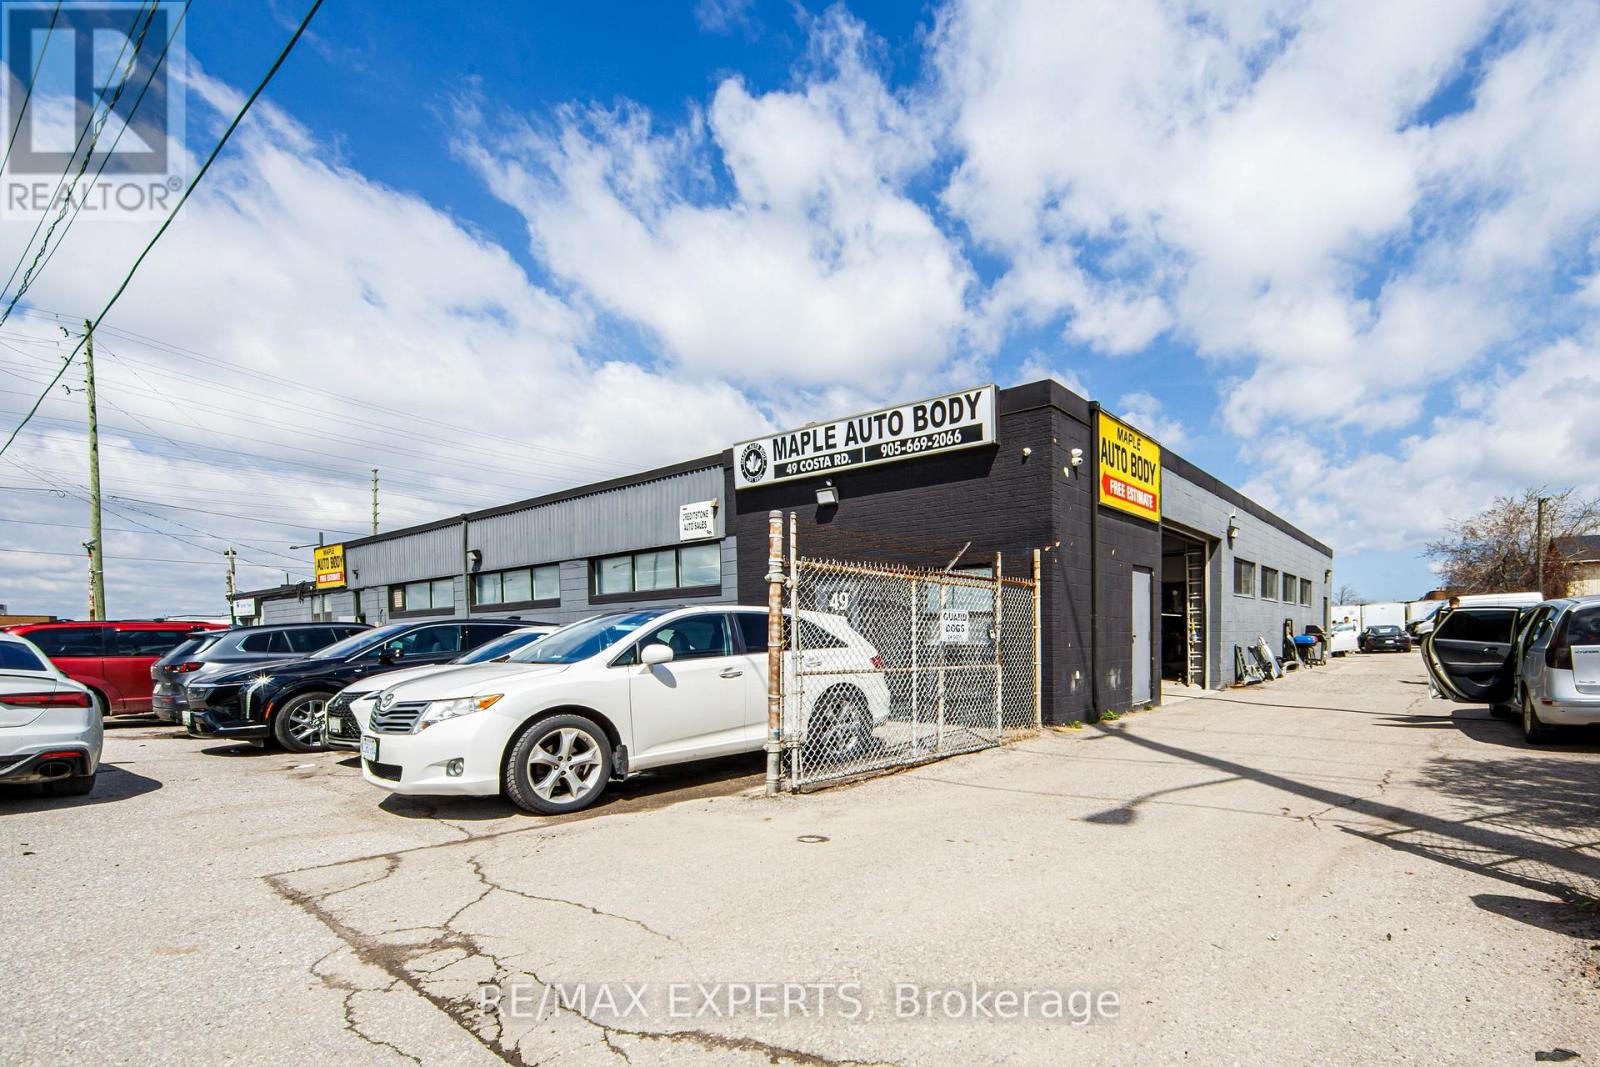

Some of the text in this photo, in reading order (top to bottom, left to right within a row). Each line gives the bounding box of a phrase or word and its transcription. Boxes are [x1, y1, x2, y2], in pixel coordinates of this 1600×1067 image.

[772, 391, 982, 461] MAPLE AUTO BODY
[880, 429, 962, 457] 905-669-2066
[1117, 427, 1141, 451] MAPLE
[786, 453, 852, 474] 49 COSTA RD.
[1101, 437, 1156, 486] AUTO BODY
[1109, 479, 1154, 509] FREE ESTIMATE
[317, 557, 330, 570] AUTO
[830, 591, 849, 611] 49
[943, 611, 968, 621] GUARD
[945, 624, 965, 633] DOGS
